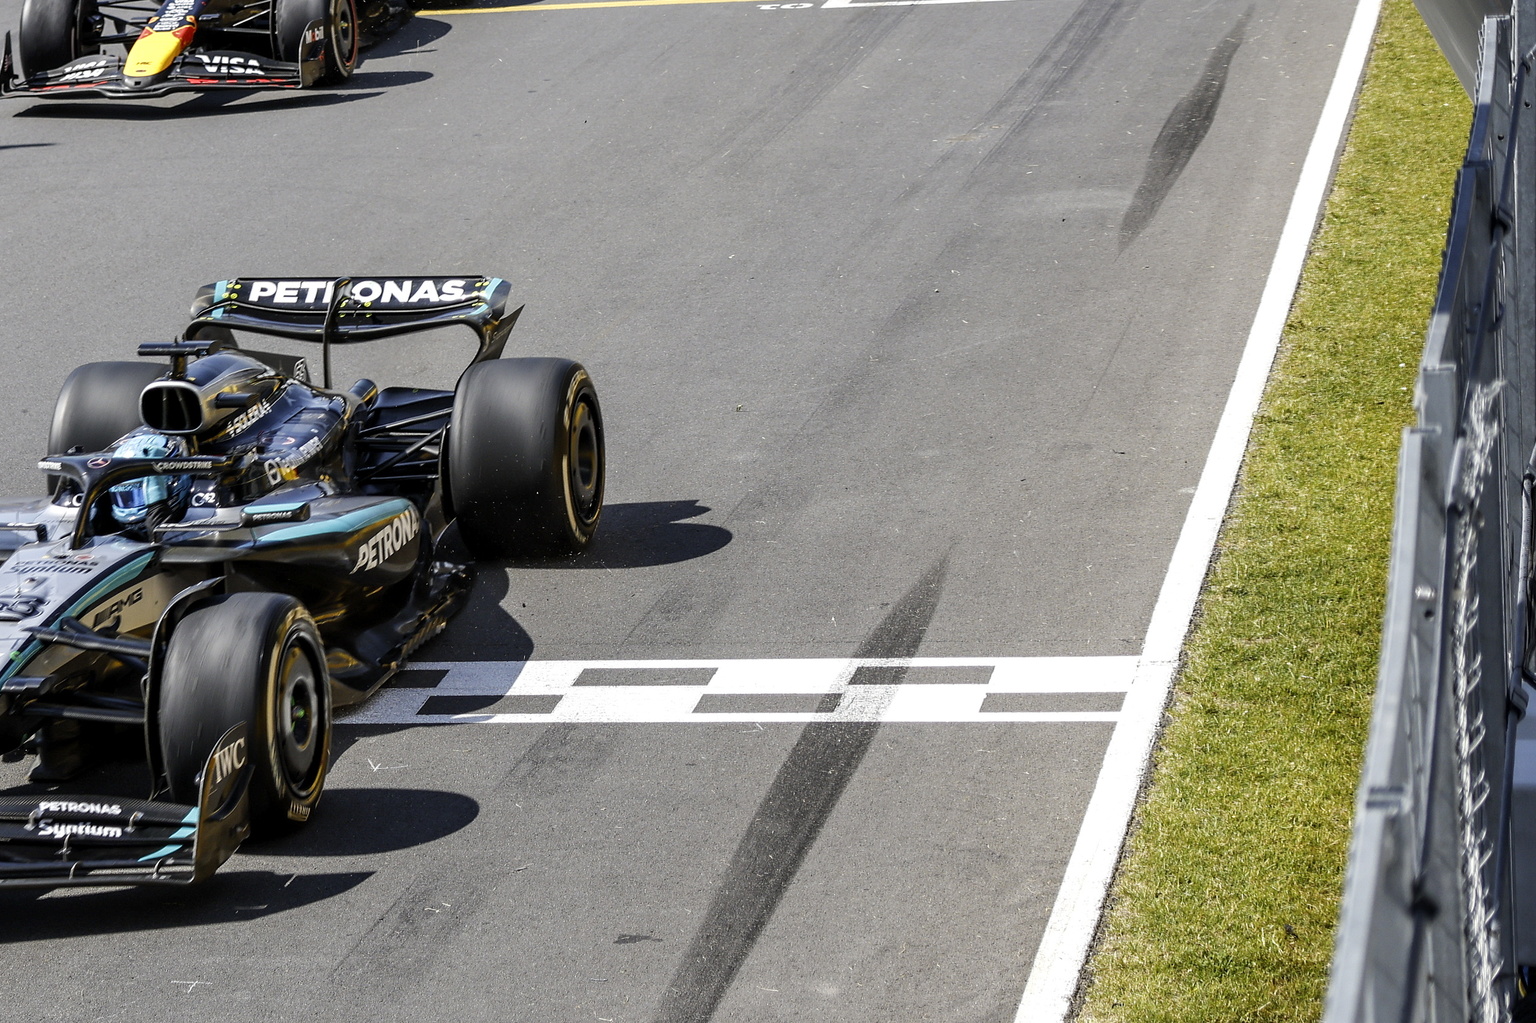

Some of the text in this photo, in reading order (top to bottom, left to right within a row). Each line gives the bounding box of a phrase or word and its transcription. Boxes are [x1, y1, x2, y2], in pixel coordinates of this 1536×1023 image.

[195, 54, 266, 75] VISA
[248, 279, 466, 304] PETONAS
[157, 460, 213, 470] CROWDSTRIKE
[252, 510, 293, 522] PETRONAS
[212, 736, 246, 784] IWC
[38, 801, 122, 815] PETRONAS
[37, 819, 123, 839] Syntium
